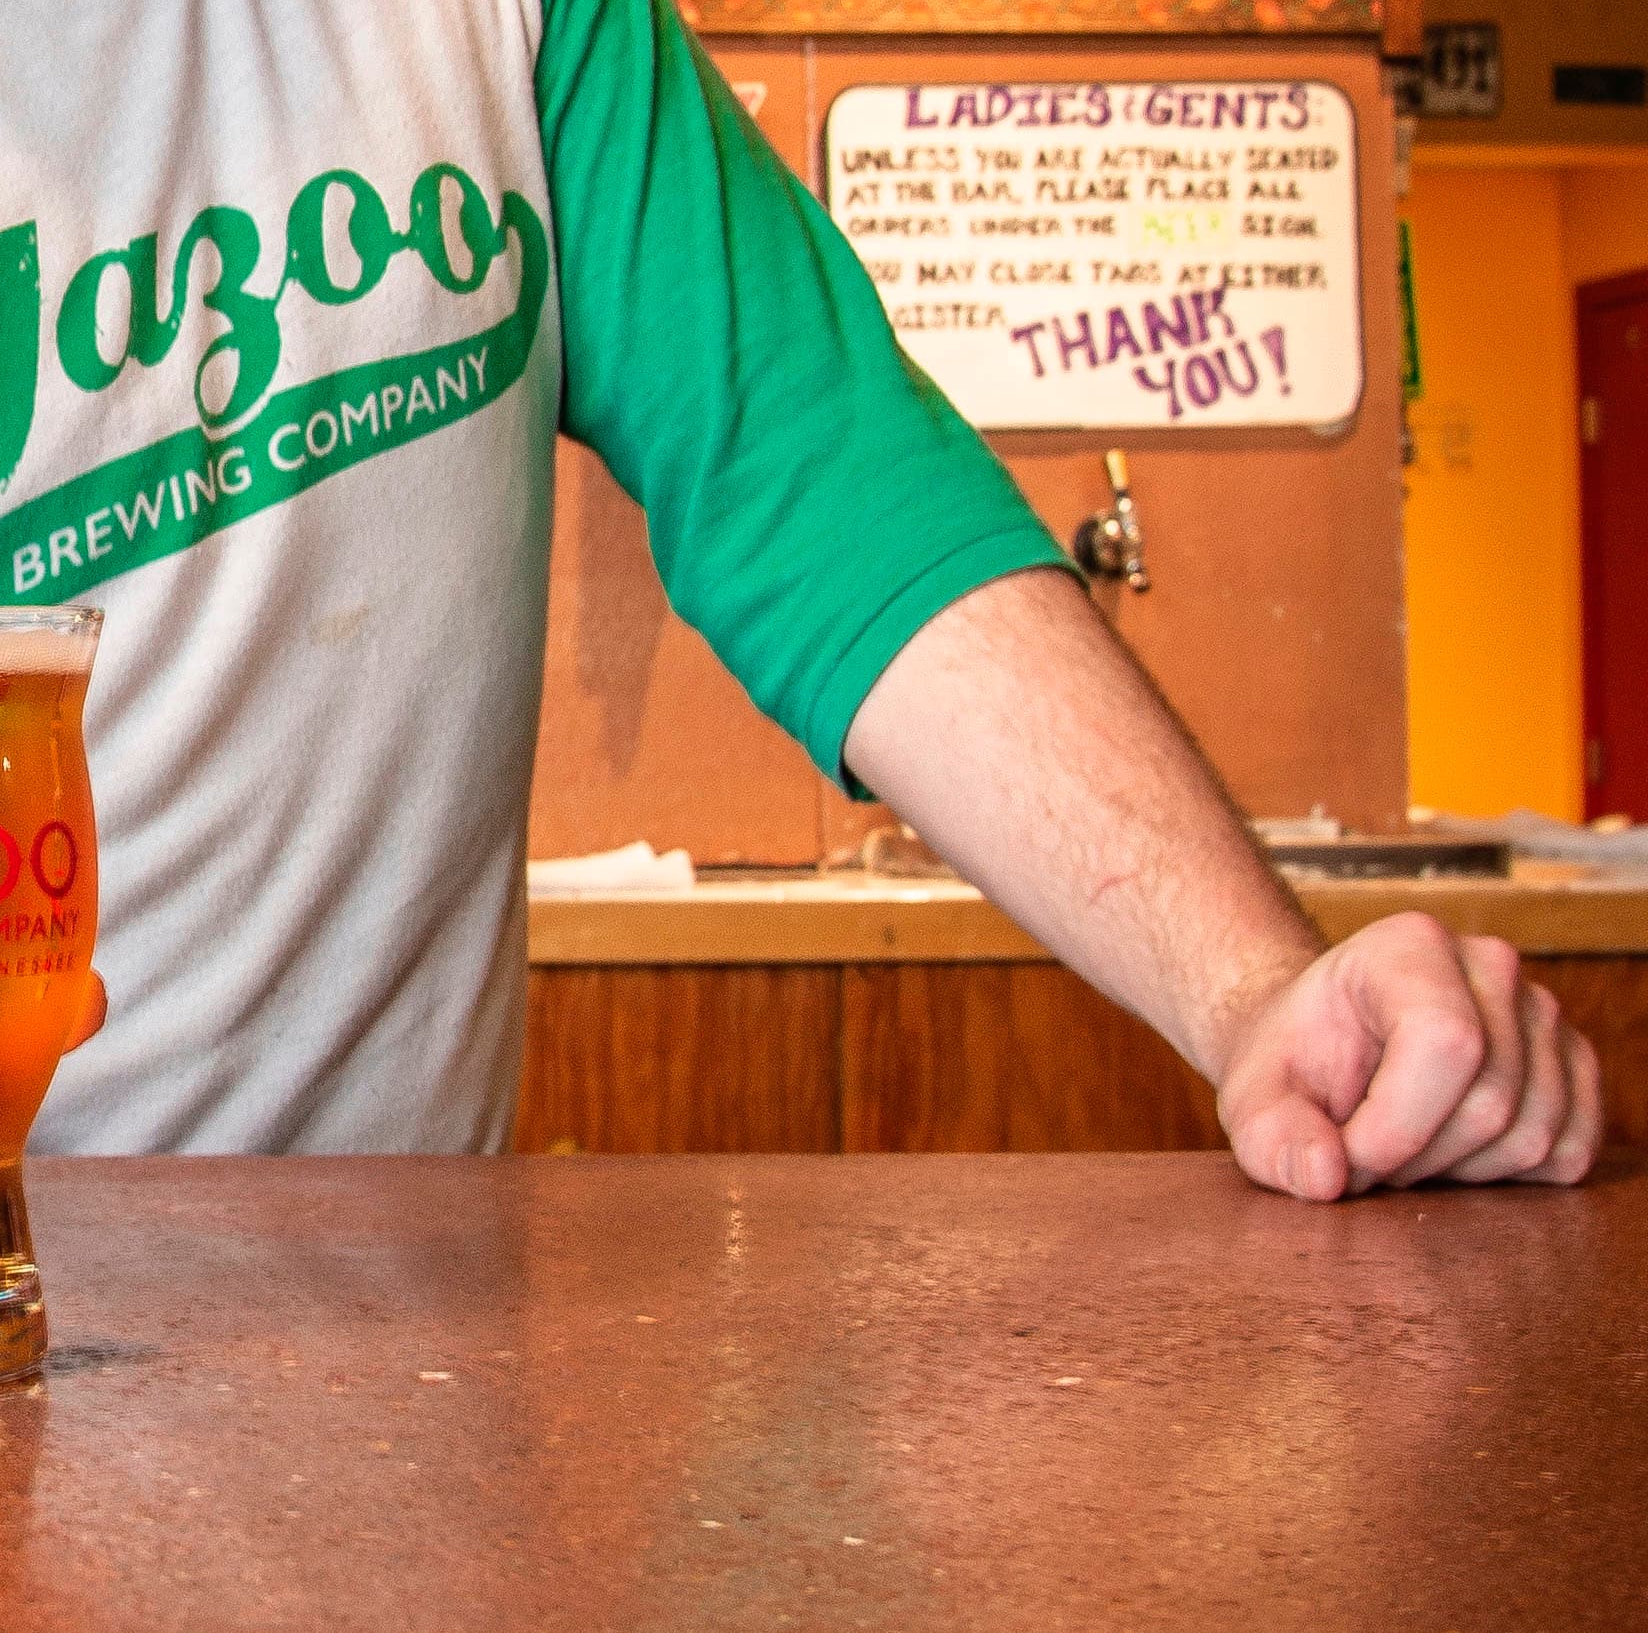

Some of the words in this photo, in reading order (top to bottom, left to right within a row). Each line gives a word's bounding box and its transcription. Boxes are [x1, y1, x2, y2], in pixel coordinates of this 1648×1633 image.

[905, 85, 1113, 130] LADIES
[841, 147, 960, 173] UNLESS
[974, 148, 1023, 171] YOU
[1036, 148, 1082, 170] ARE
[1099, 146, 1235, 171] ACTUALLY
[1247, 146, 1339, 171] SEATED
[846, 181, 881, 205] AT
[895, 181, 936, 203] THE
[1037, 178, 1129, 204] PLEASE
[1146, 177, 1229, 202] PLACE
[1248, 180, 1303, 201] ALL
[849, 216, 951, 237] ORDERS
[970, 216, 1061, 236] UNDER
[1074, 215, 1116, 236] THE
[917, 262, 976, 285] MAY
[989, 262, 1072, 285] CLOSE
[1091, 261, 1163, 284] TABS
[1177, 264, 1208, 285] AT
[1010, 283, 1237, 379] THANK
[1132, 325, 1294, 419] YOU!
[12, 447, 252, 595] BREWING
[267, 346, 491, 473] COMPANY
